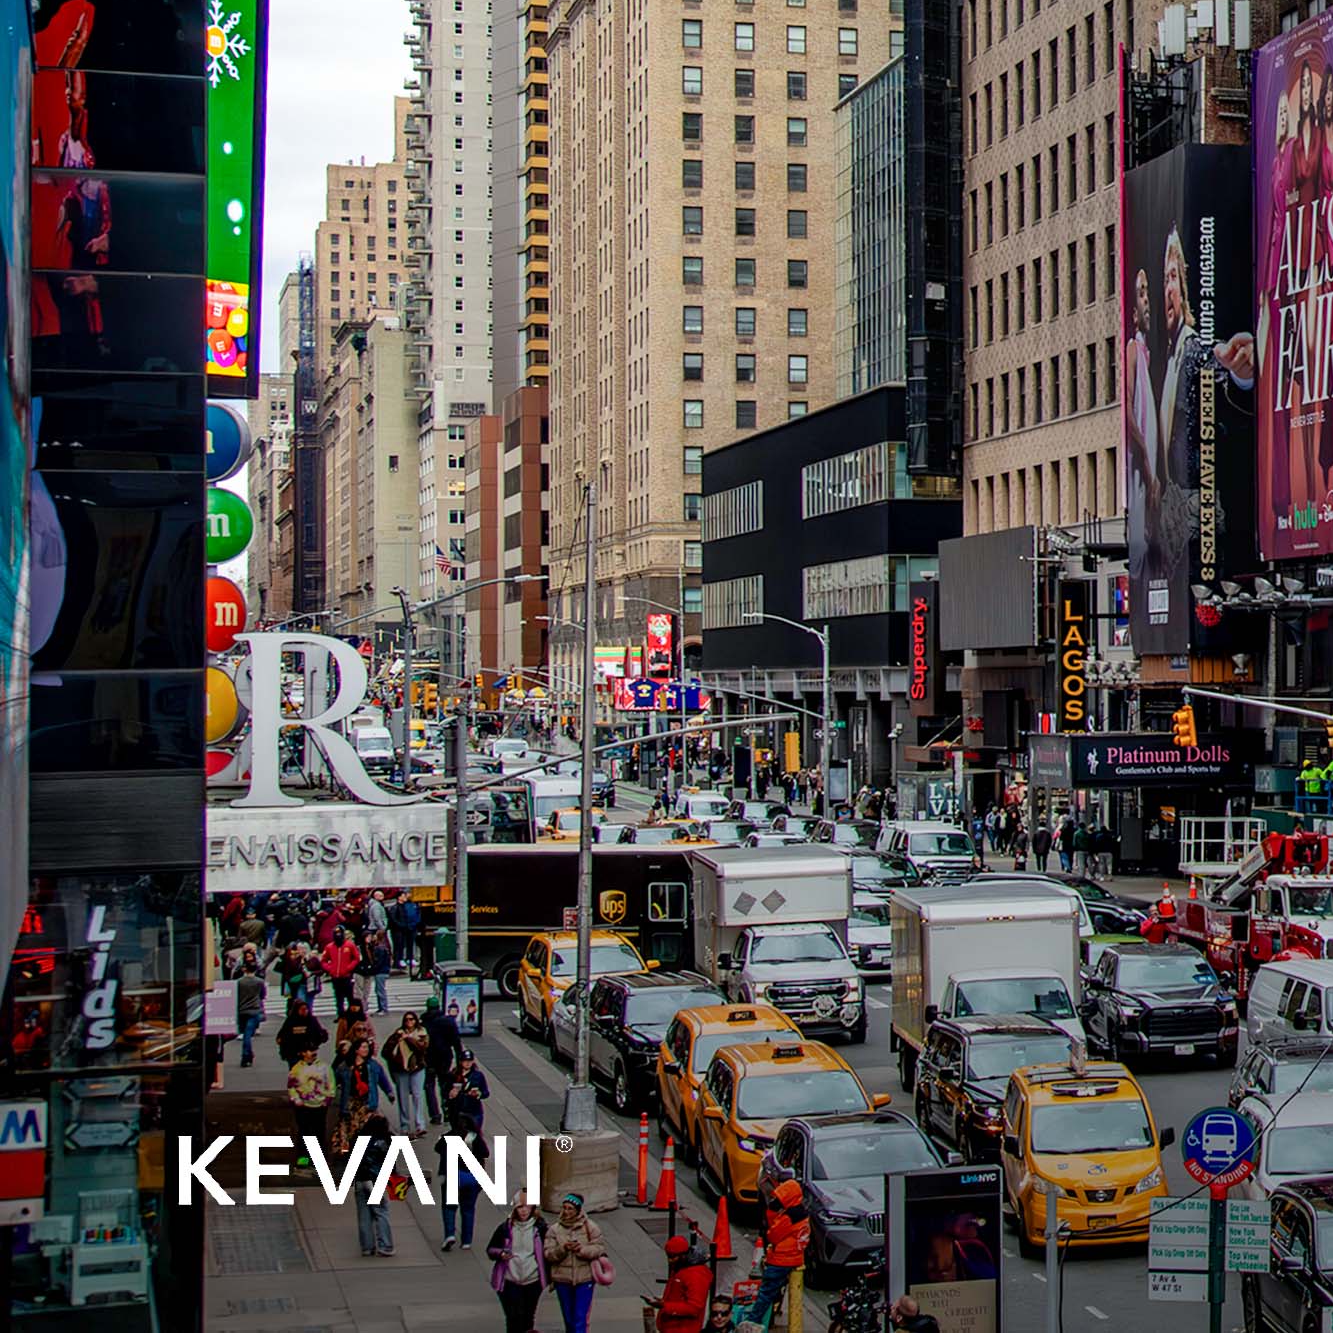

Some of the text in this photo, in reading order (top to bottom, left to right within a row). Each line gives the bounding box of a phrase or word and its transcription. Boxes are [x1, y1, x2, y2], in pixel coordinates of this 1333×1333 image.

[1200, 367, 1215, 440] HEELS
[1200, 442, 1215, 503] HAVE
[1294, 500, 1318, 530] hulu
[1200, 503, 1216, 565] EYES
[1063, 600, 1085, 721] LAGOS
[231, 632, 433, 807] R
[1107, 746, 1231, 764] Platinum Dolls
[1157, 766, 1173, 774] Club
[1174, 766, 1187, 774] and
[1188, 766, 1209, 775] Sports
[470, 905, 498, 914] Services
[603, 899, 624, 918] ups
[83, 905, 117, 1049] Lids
[961, 1172, 997, 1184] LinkNYC
[1188, 1161, 1249, 1186] NO STANDING
[1229, 1227, 1256, 1237] New York
[1229, 1252, 1260, 1262] Top View
[1158, 1275, 1170, 1283] Av
[1162, 1284, 1182, 1292] 47 St
